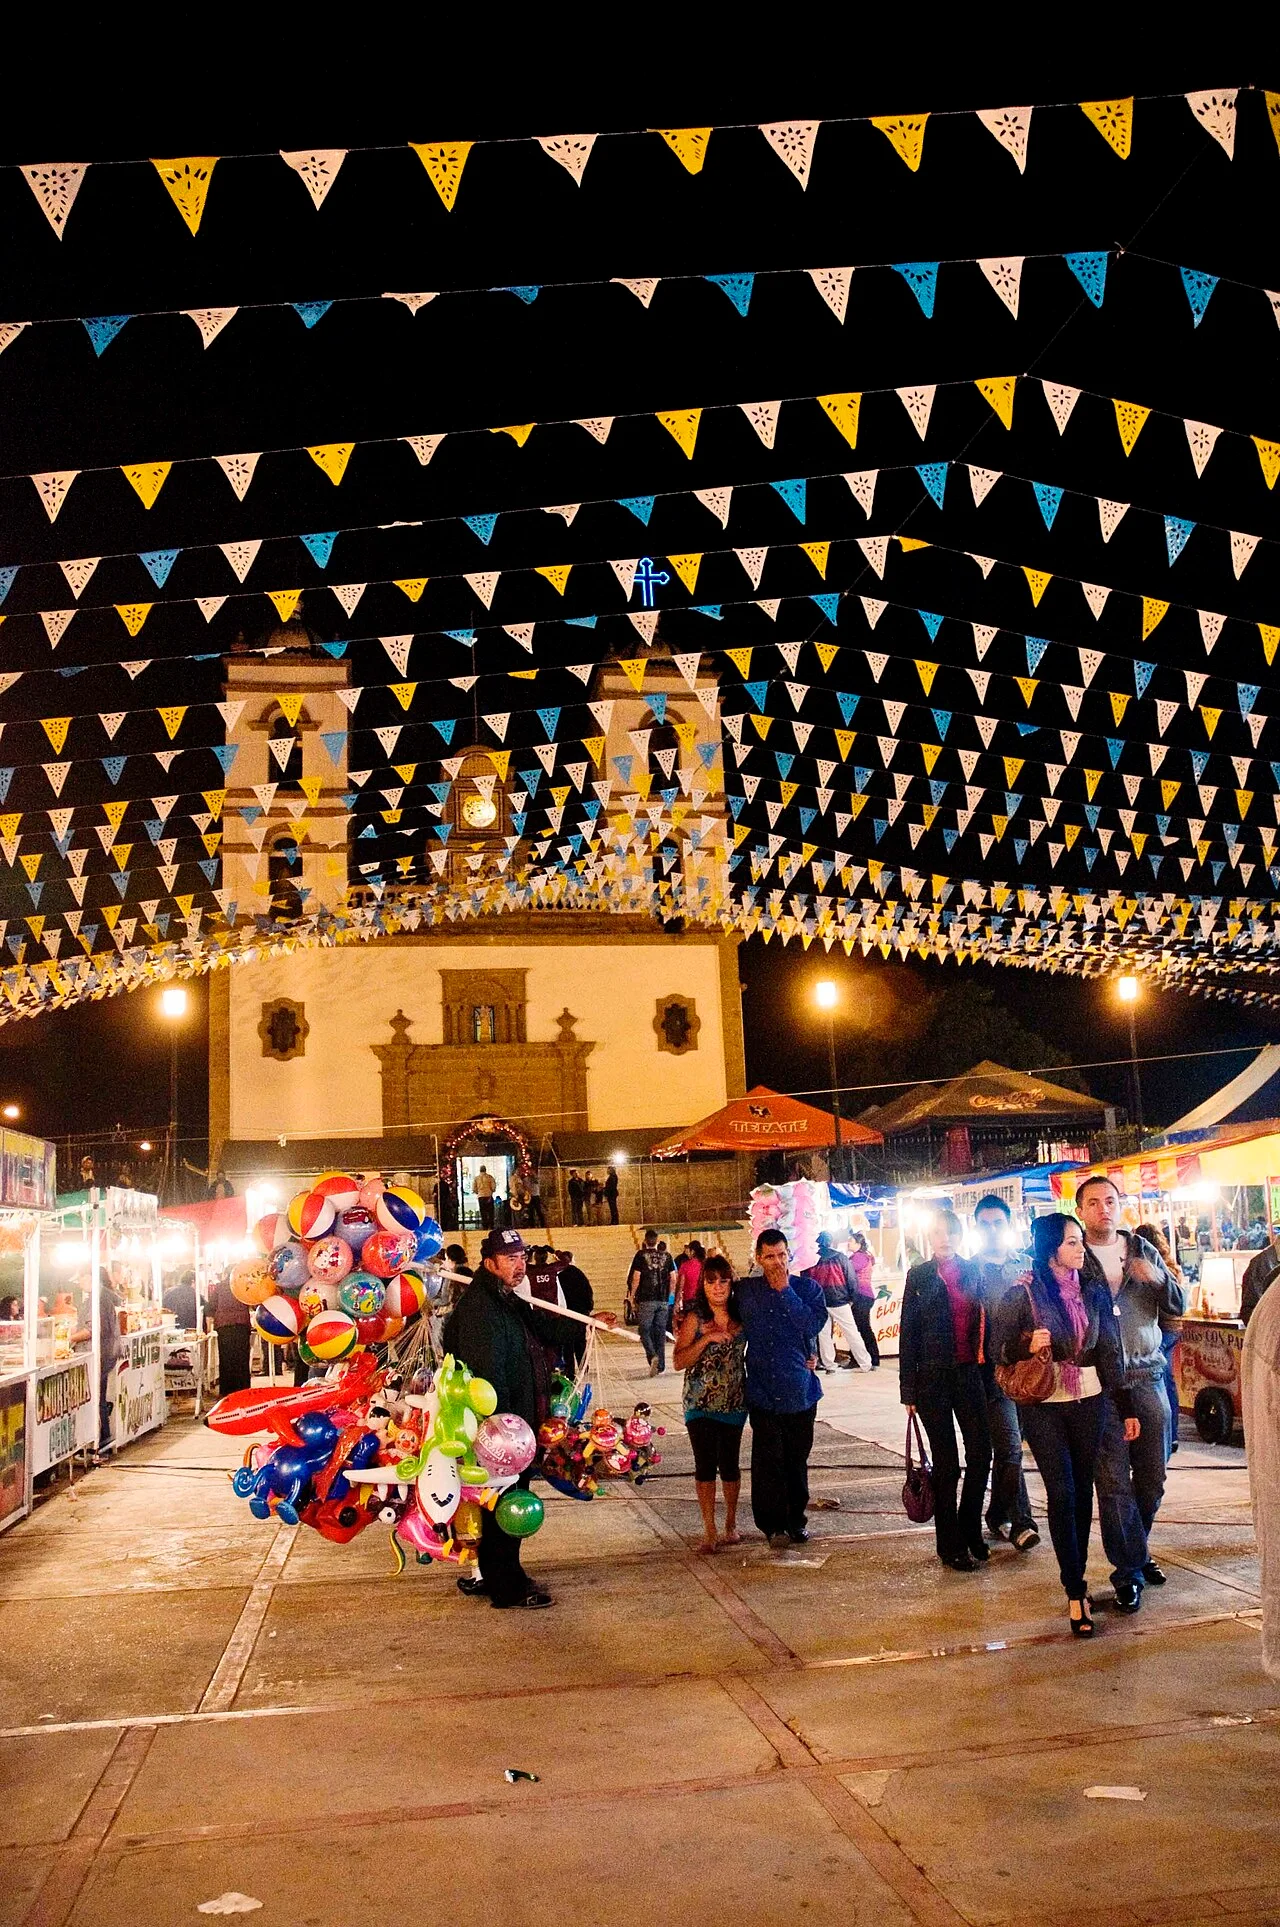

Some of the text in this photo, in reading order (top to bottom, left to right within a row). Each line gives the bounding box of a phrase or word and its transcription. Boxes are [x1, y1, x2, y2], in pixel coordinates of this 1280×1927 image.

[728, 1119, 808, 1134] TECATE
[536, 1274, 550, 1283] ESG
[877, 1323, 902, 1342] ESQ
